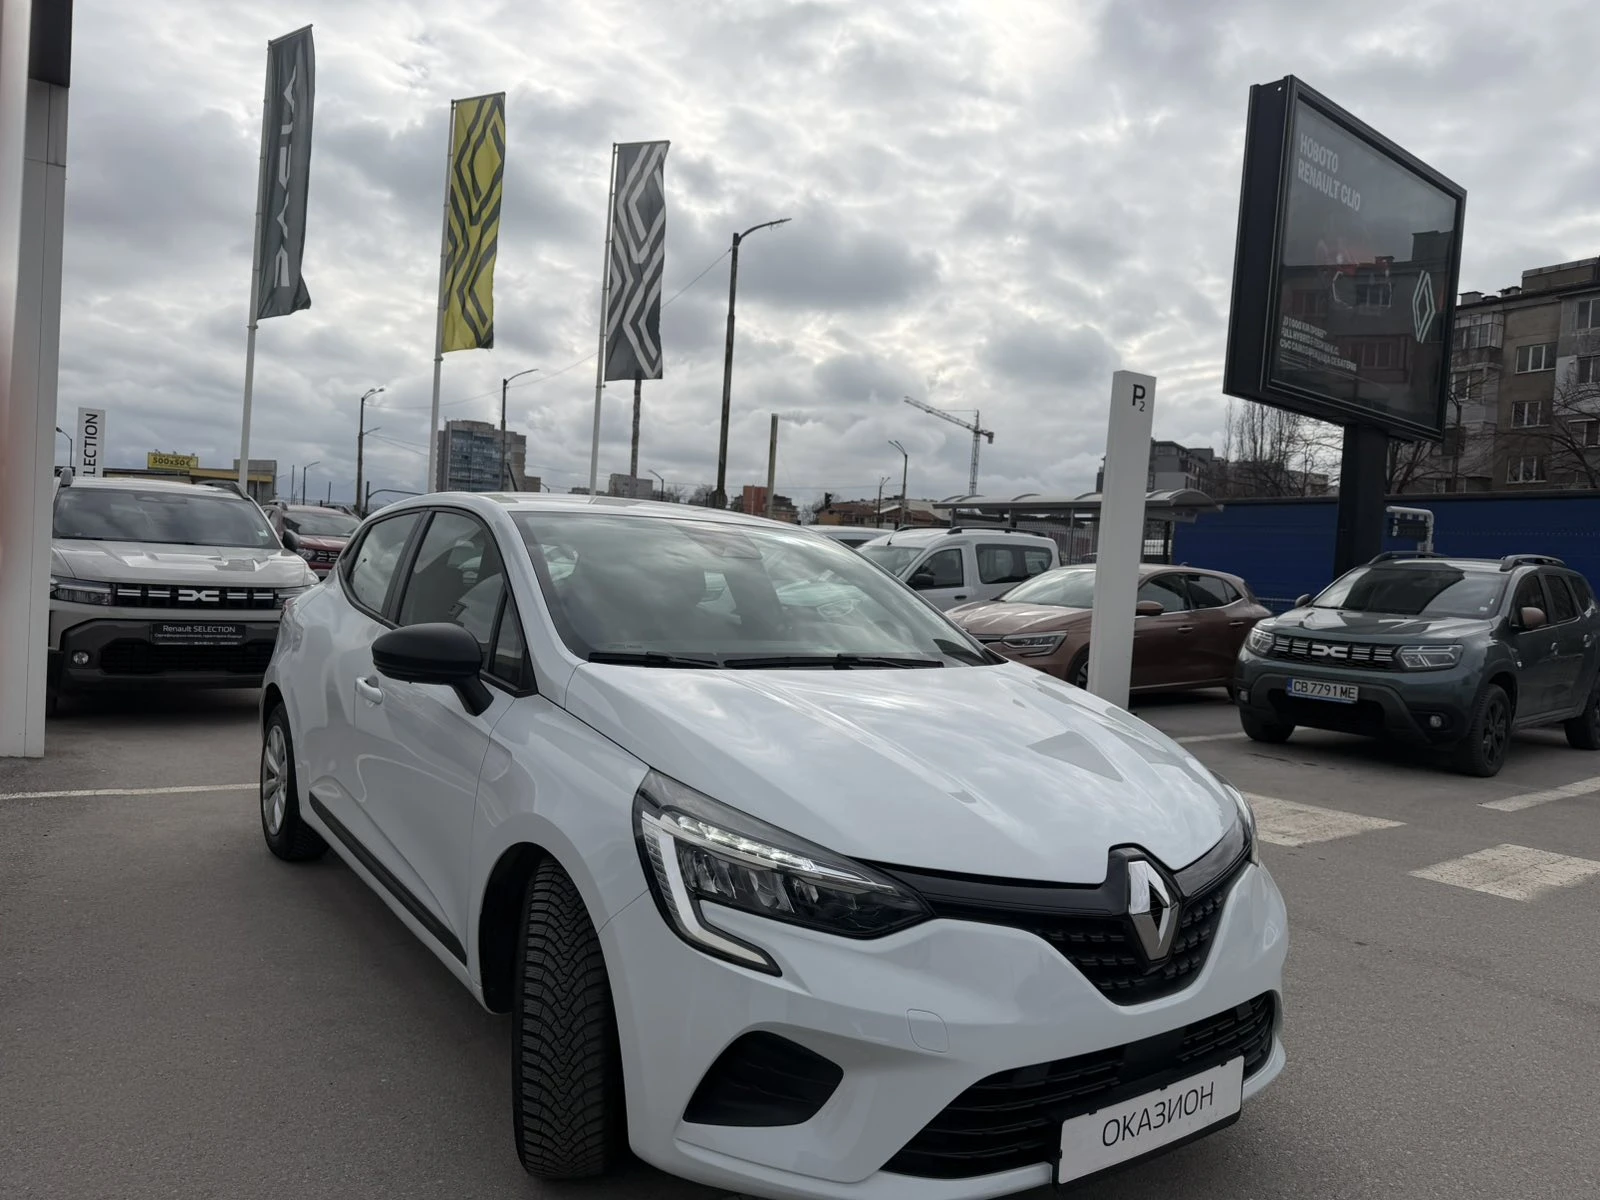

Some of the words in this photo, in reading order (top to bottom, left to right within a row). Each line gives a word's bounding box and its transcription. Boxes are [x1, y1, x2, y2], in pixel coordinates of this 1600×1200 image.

[1300, 133, 1338, 173] НОВОТО
[1297, 158, 1340, 199] RENAULT
[1341, 184, 1361, 212] CLIO
[163, 624, 192, 632] Renault
[193, 625, 236, 633] SELECTION
[1102, 1081, 1214, 1148] ОКАЗИОН
